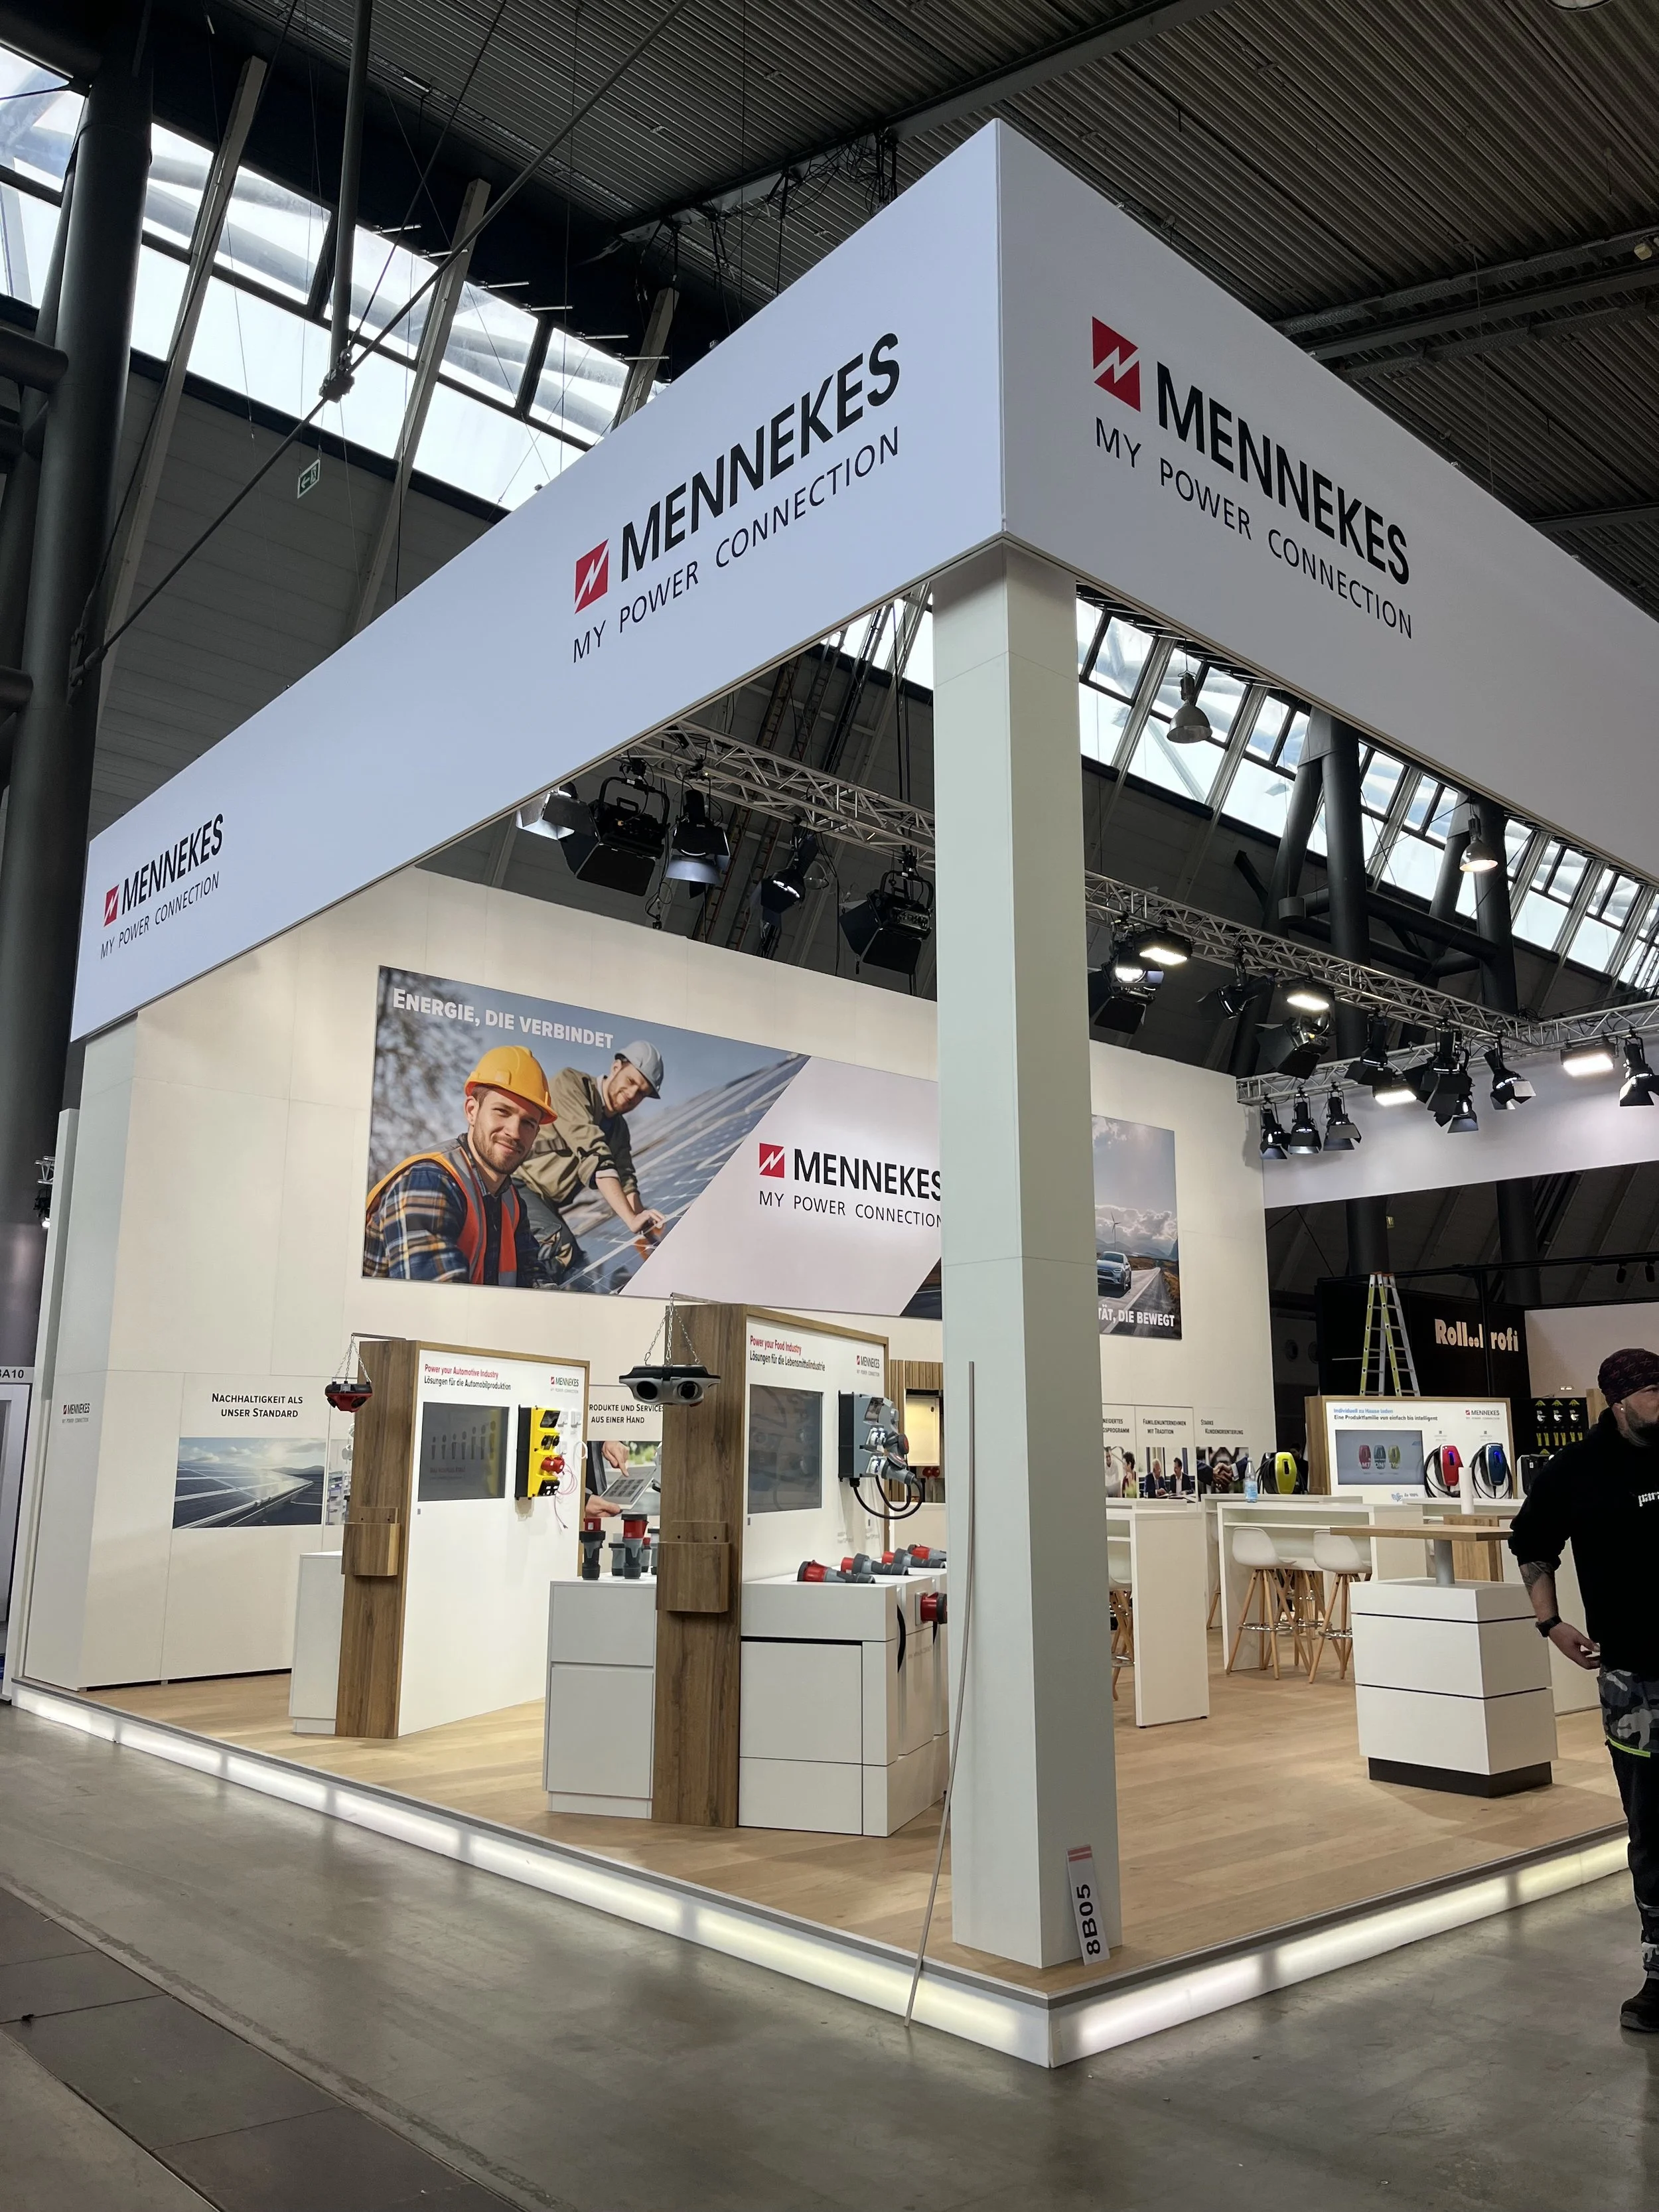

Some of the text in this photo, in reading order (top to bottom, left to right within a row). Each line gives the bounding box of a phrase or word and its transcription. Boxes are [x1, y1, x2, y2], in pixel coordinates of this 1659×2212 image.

[621, 332, 900, 582] MENNEKES
[1157, 361, 1410, 585] MENNEKES
[1096, 417, 1412, 639] MY POWER CONNECTION
[573, 426, 899, 663] MY POWER CONNECTION
[121, 814, 224, 915] MENNEKES
[100, 871, 220, 959] MY POWER CONNECTION
[393, 988, 614, 1049] ENERGIE, DIE VERBINDET
[794, 1148, 941, 1202] MENNEKES
[759, 1191, 784, 1207] MY
[794, 1195, 846, 1216] POWER
[1118, 1309, 1135, 1323] DIE
[1137, 1311, 1175, 1327] BEWEGT
[750, 1335, 802, 1356] Power your Food Industry
[750, 1350, 770, 1365] Lösungen
[861, 1355, 880, 1369] MENNEKES
[0, 1368, 25, 1378] A10
[424, 1375, 448, 1386] Lösungen
[465, 1379, 512, 1390] Automobilproduktion
[425, 1364, 499, 1380] Power your Automotive Industry
[555, 1376, 579, 1387] MENNEKES
[67, 1402, 90, 1414] MENNEKES
[212, 1393, 285, 1404] NACHHALTIGKEIT
[221, 1408, 299, 1418] UNSER STANDARD
[1076, 1883, 1101, 1955] 8B05
